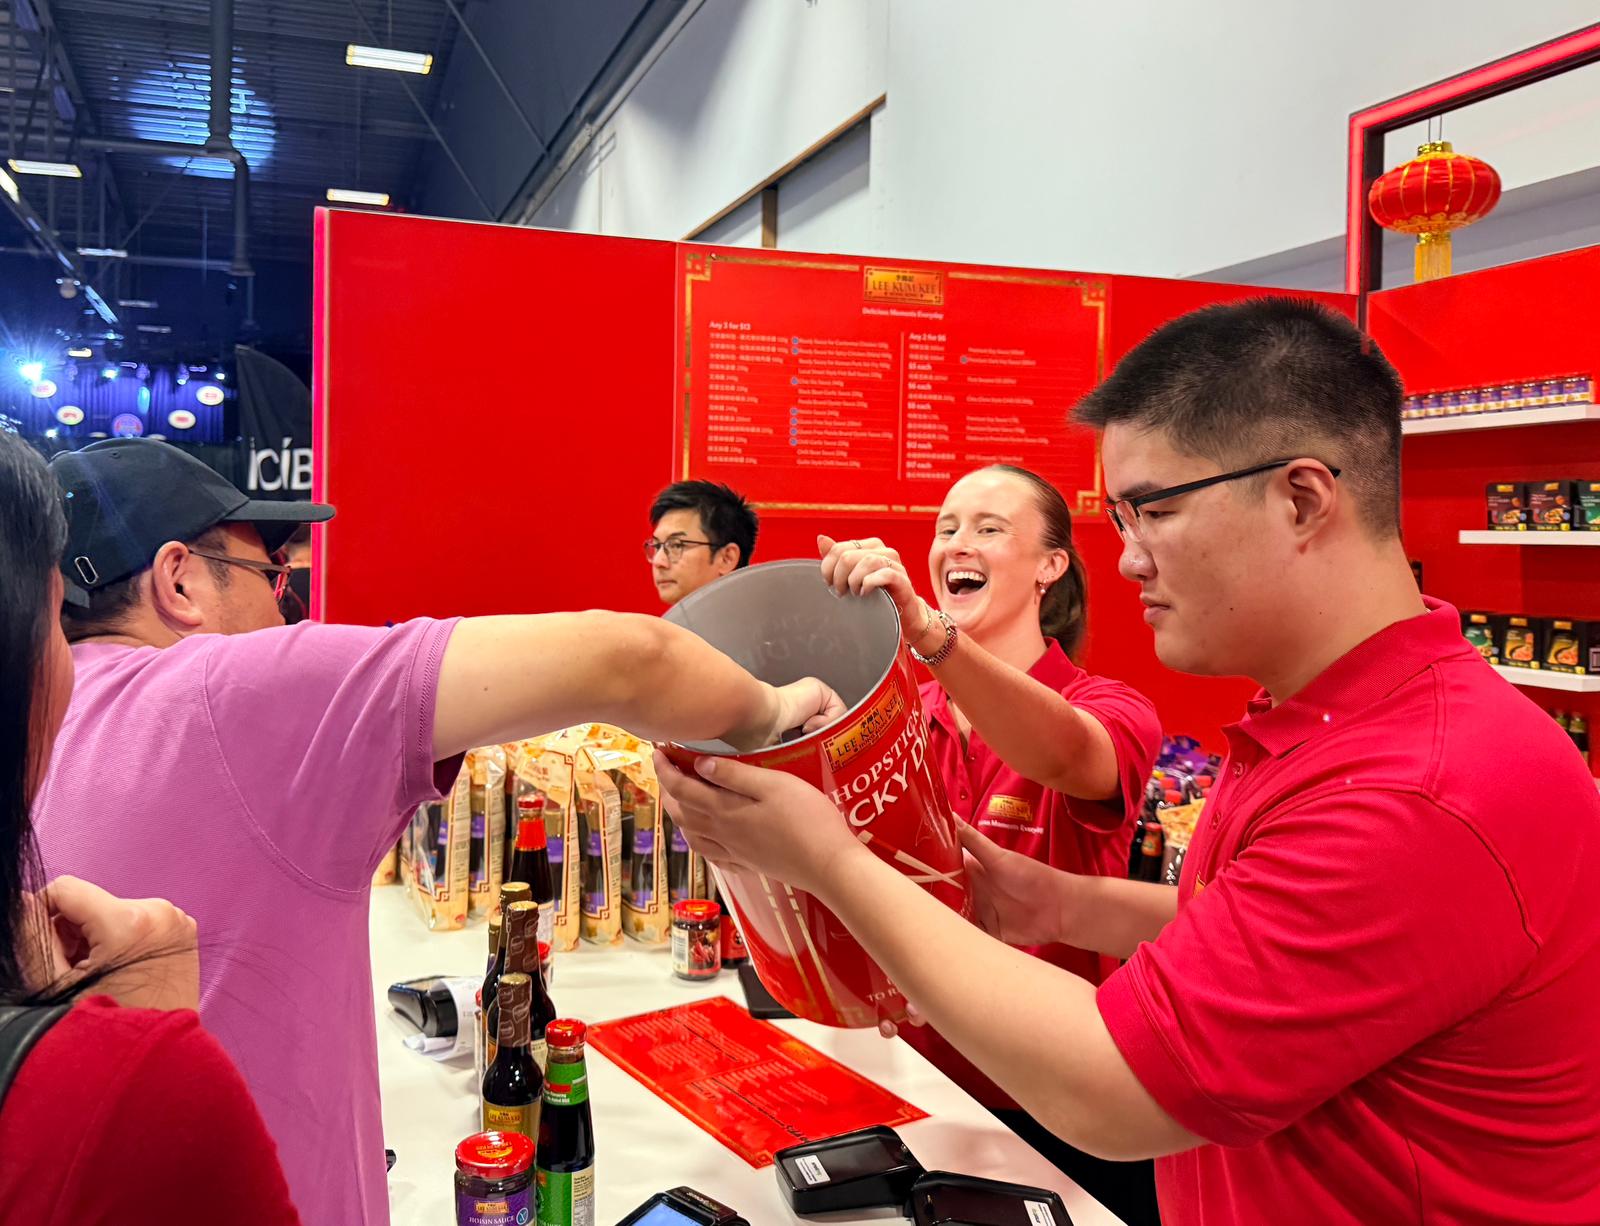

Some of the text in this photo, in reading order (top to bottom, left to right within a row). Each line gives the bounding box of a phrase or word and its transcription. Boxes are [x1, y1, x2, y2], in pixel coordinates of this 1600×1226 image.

[872, 280, 888, 291] LEE
[709, 321, 722, 330] Any
[836, 737, 857, 757] LEE
[860, 715, 885, 743] KUM
[830, 700, 919, 805] HOPSTICK
[842, 758, 908, 827] CKY
[469, 1214, 514, 1225] HOISIN SAUCE
